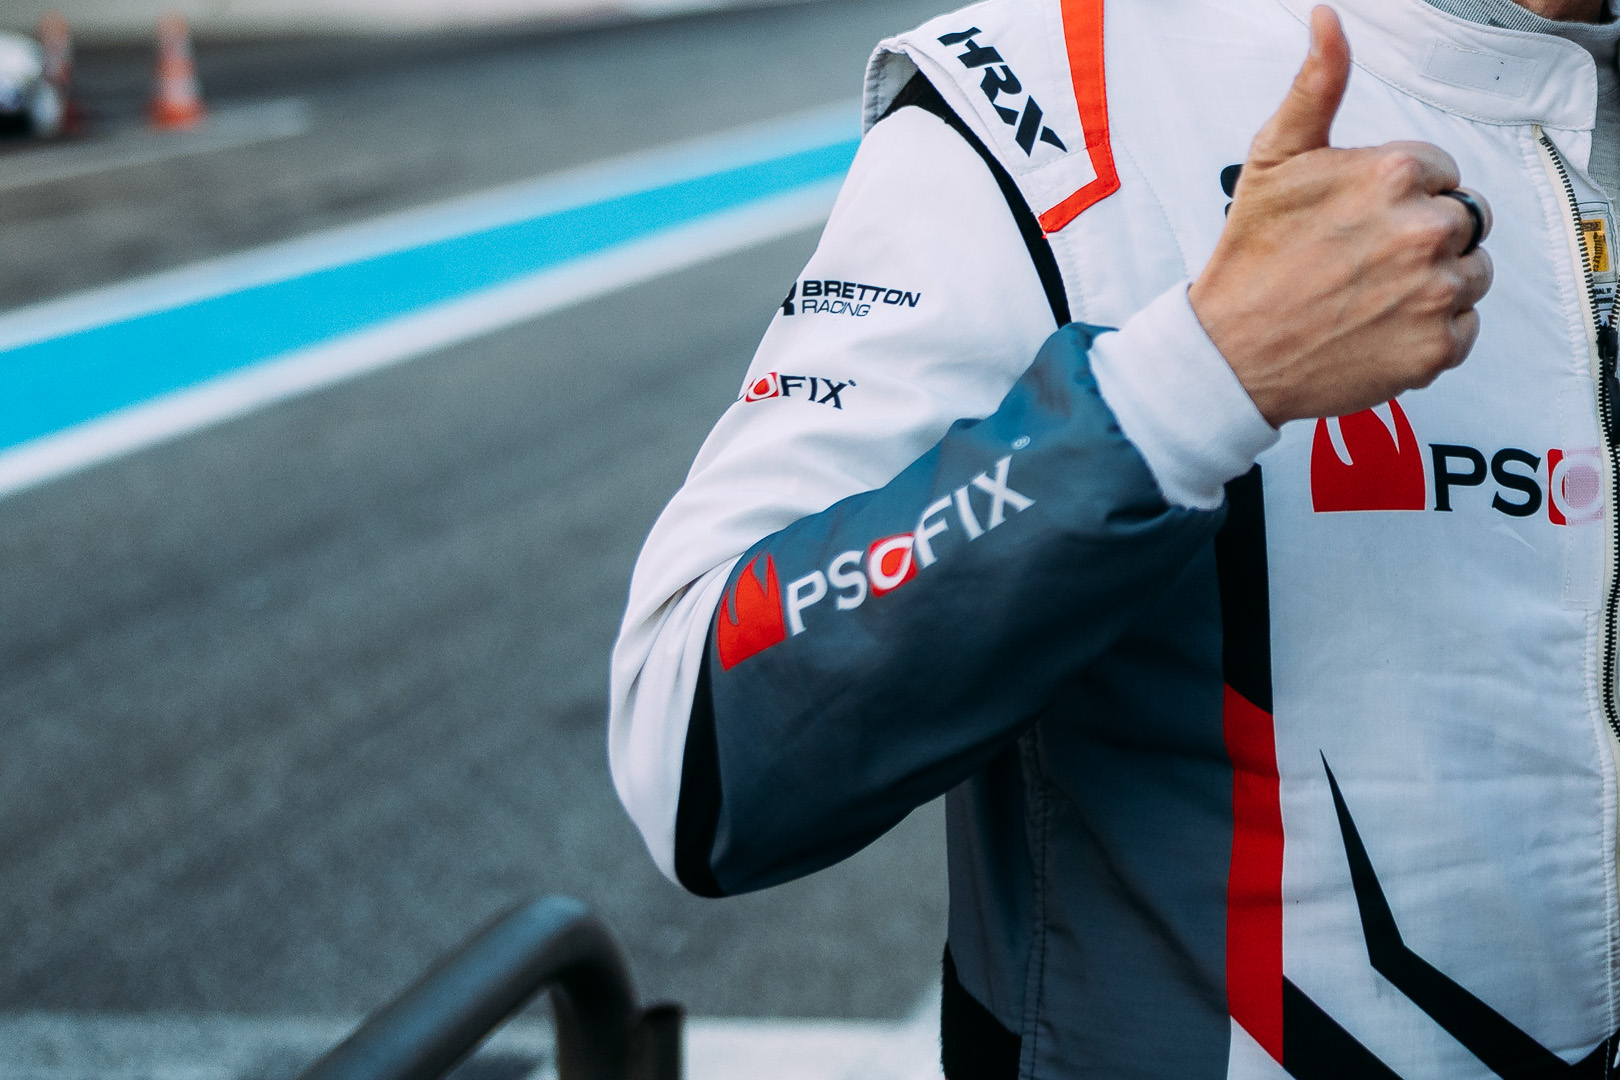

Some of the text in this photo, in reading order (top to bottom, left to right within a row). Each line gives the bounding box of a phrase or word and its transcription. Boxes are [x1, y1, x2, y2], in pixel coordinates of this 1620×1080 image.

[937, 26, 1068, 158] HRX
[802, 280, 921, 308] BRETTON
[802, 299, 871, 317] RACING
[739, 371, 848, 410] OFIX
[787, 455, 1037, 637] PSOFIX
